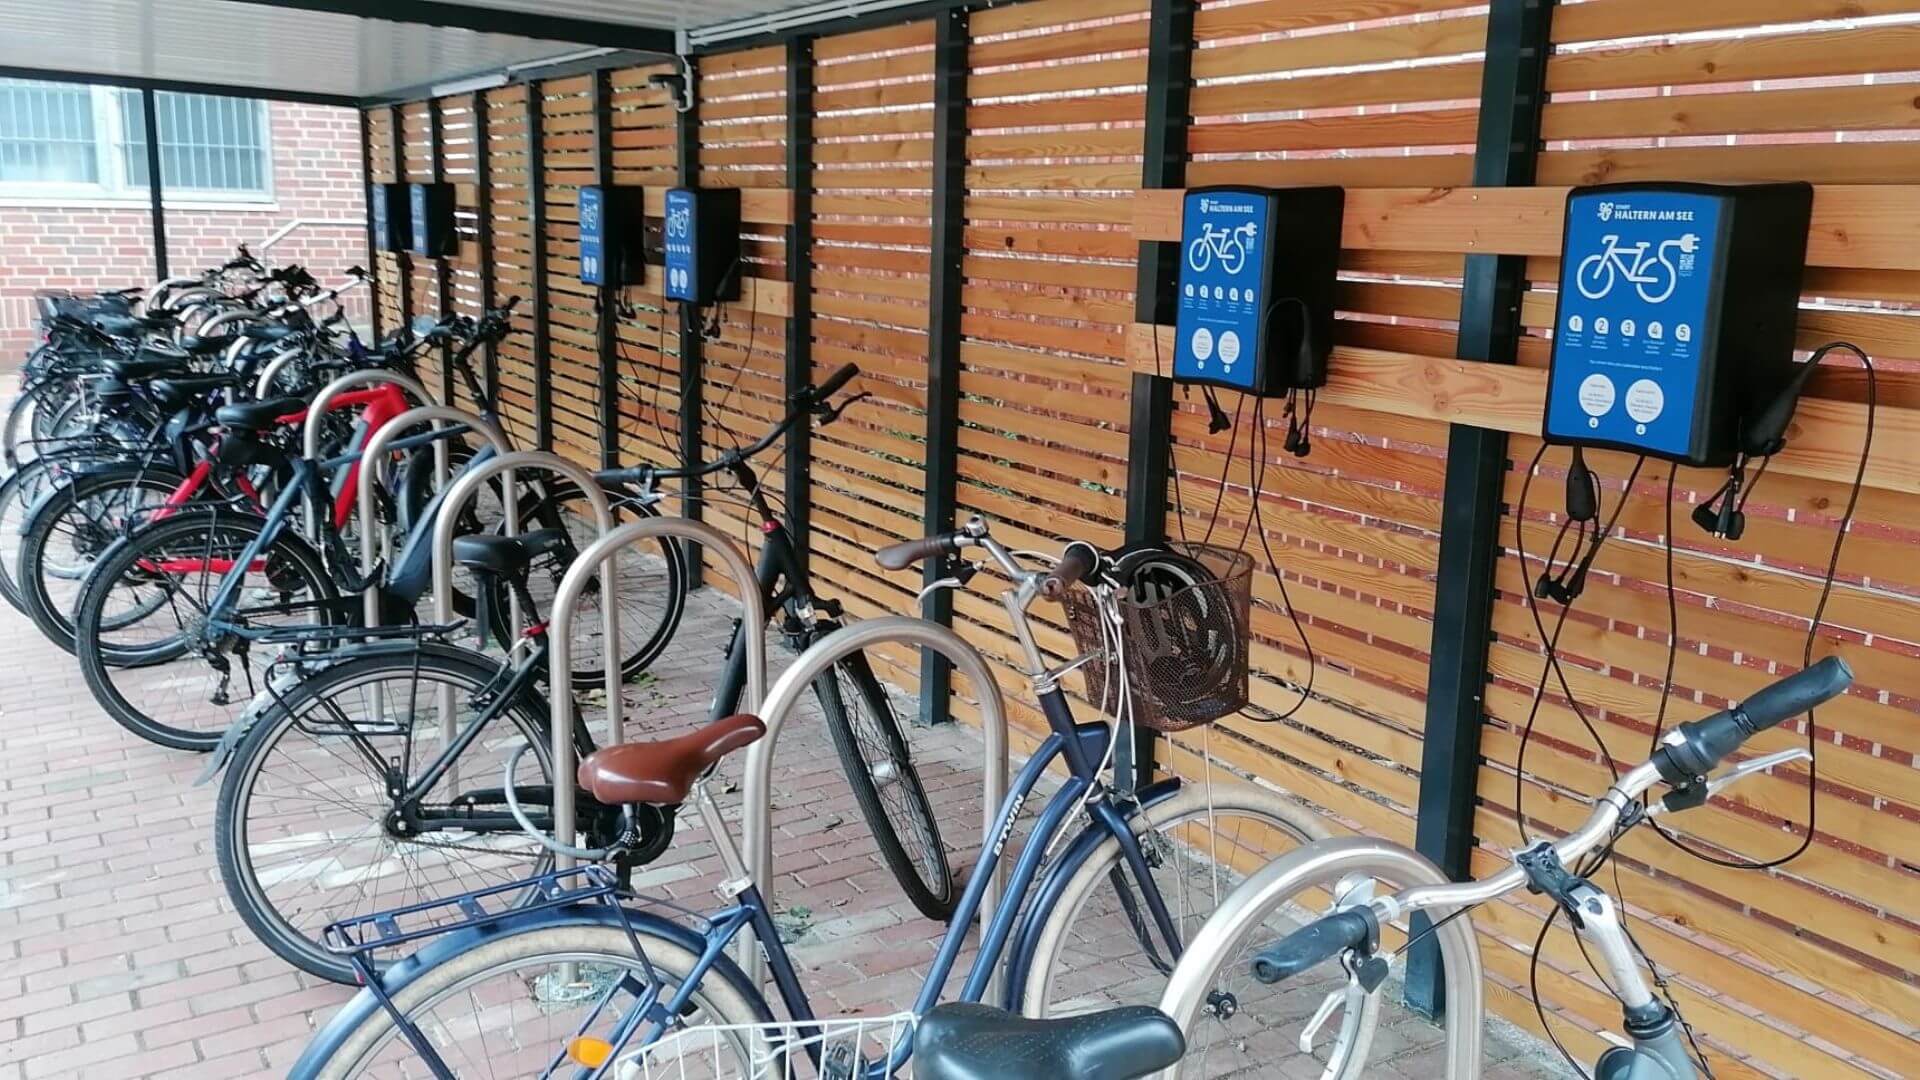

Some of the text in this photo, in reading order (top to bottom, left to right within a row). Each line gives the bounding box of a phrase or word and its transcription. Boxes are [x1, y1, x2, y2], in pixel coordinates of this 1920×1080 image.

[1614, 209, 1694, 221] HALTERN AM SEE
